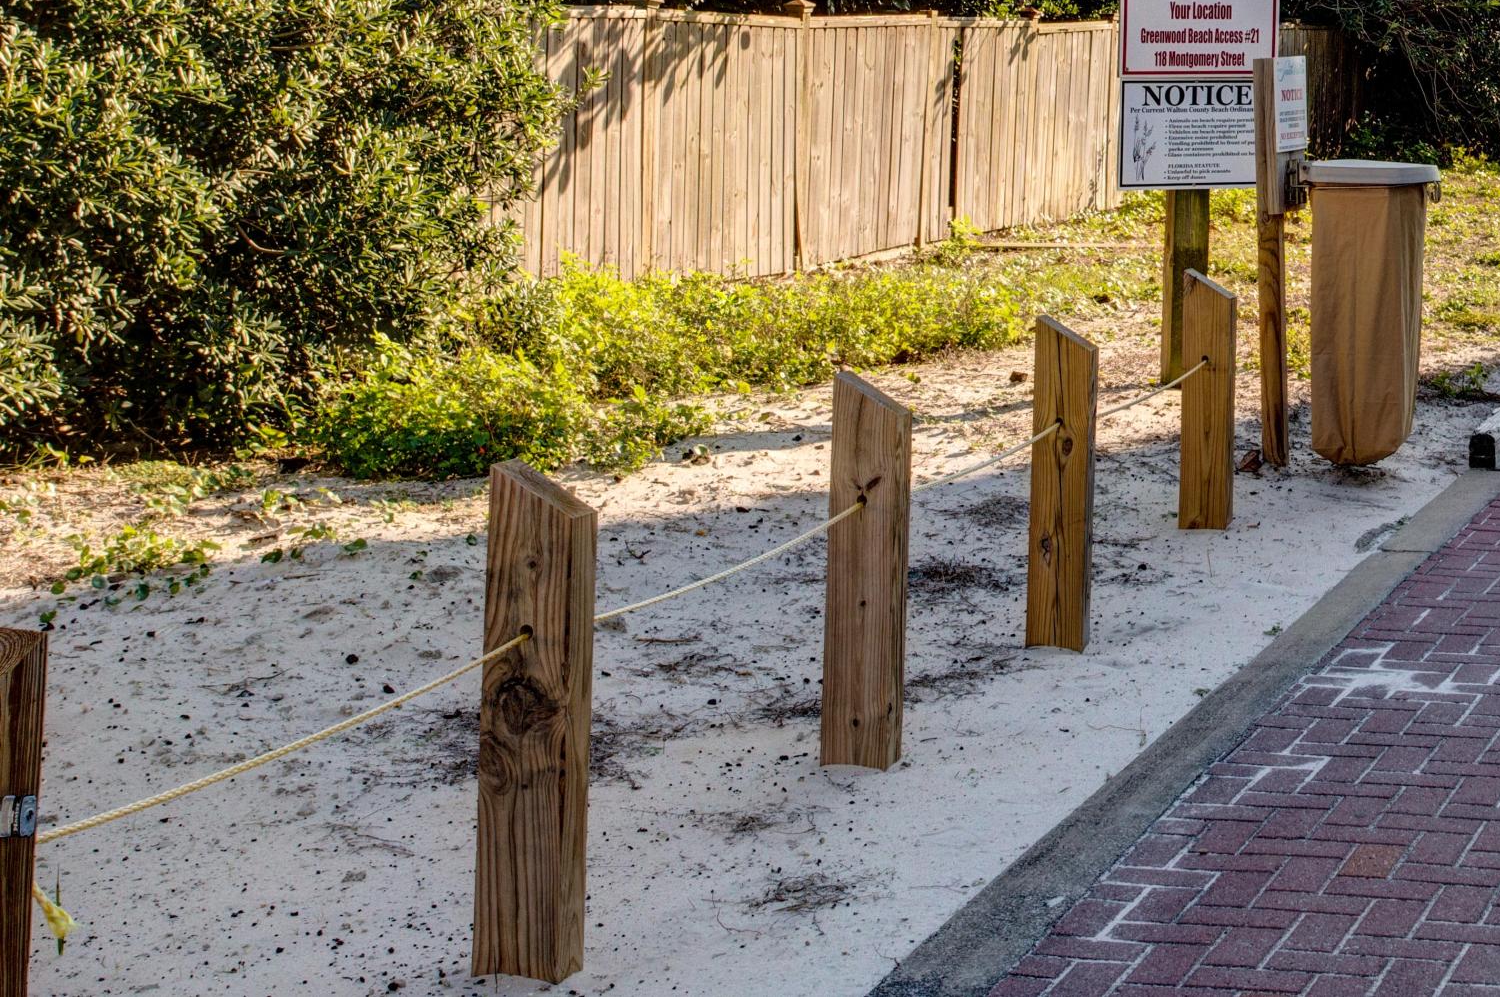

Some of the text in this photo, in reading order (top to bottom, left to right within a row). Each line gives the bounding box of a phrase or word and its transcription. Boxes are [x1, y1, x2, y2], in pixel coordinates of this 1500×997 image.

[1170, 2, 1232, 19] Your Location
[1141, 28, 1259, 43] Greenwood Beach Access #21
[1154, 51, 1244, 69] 118 Montgomery Street
[1142, 85, 1252, 106] NOTICE
